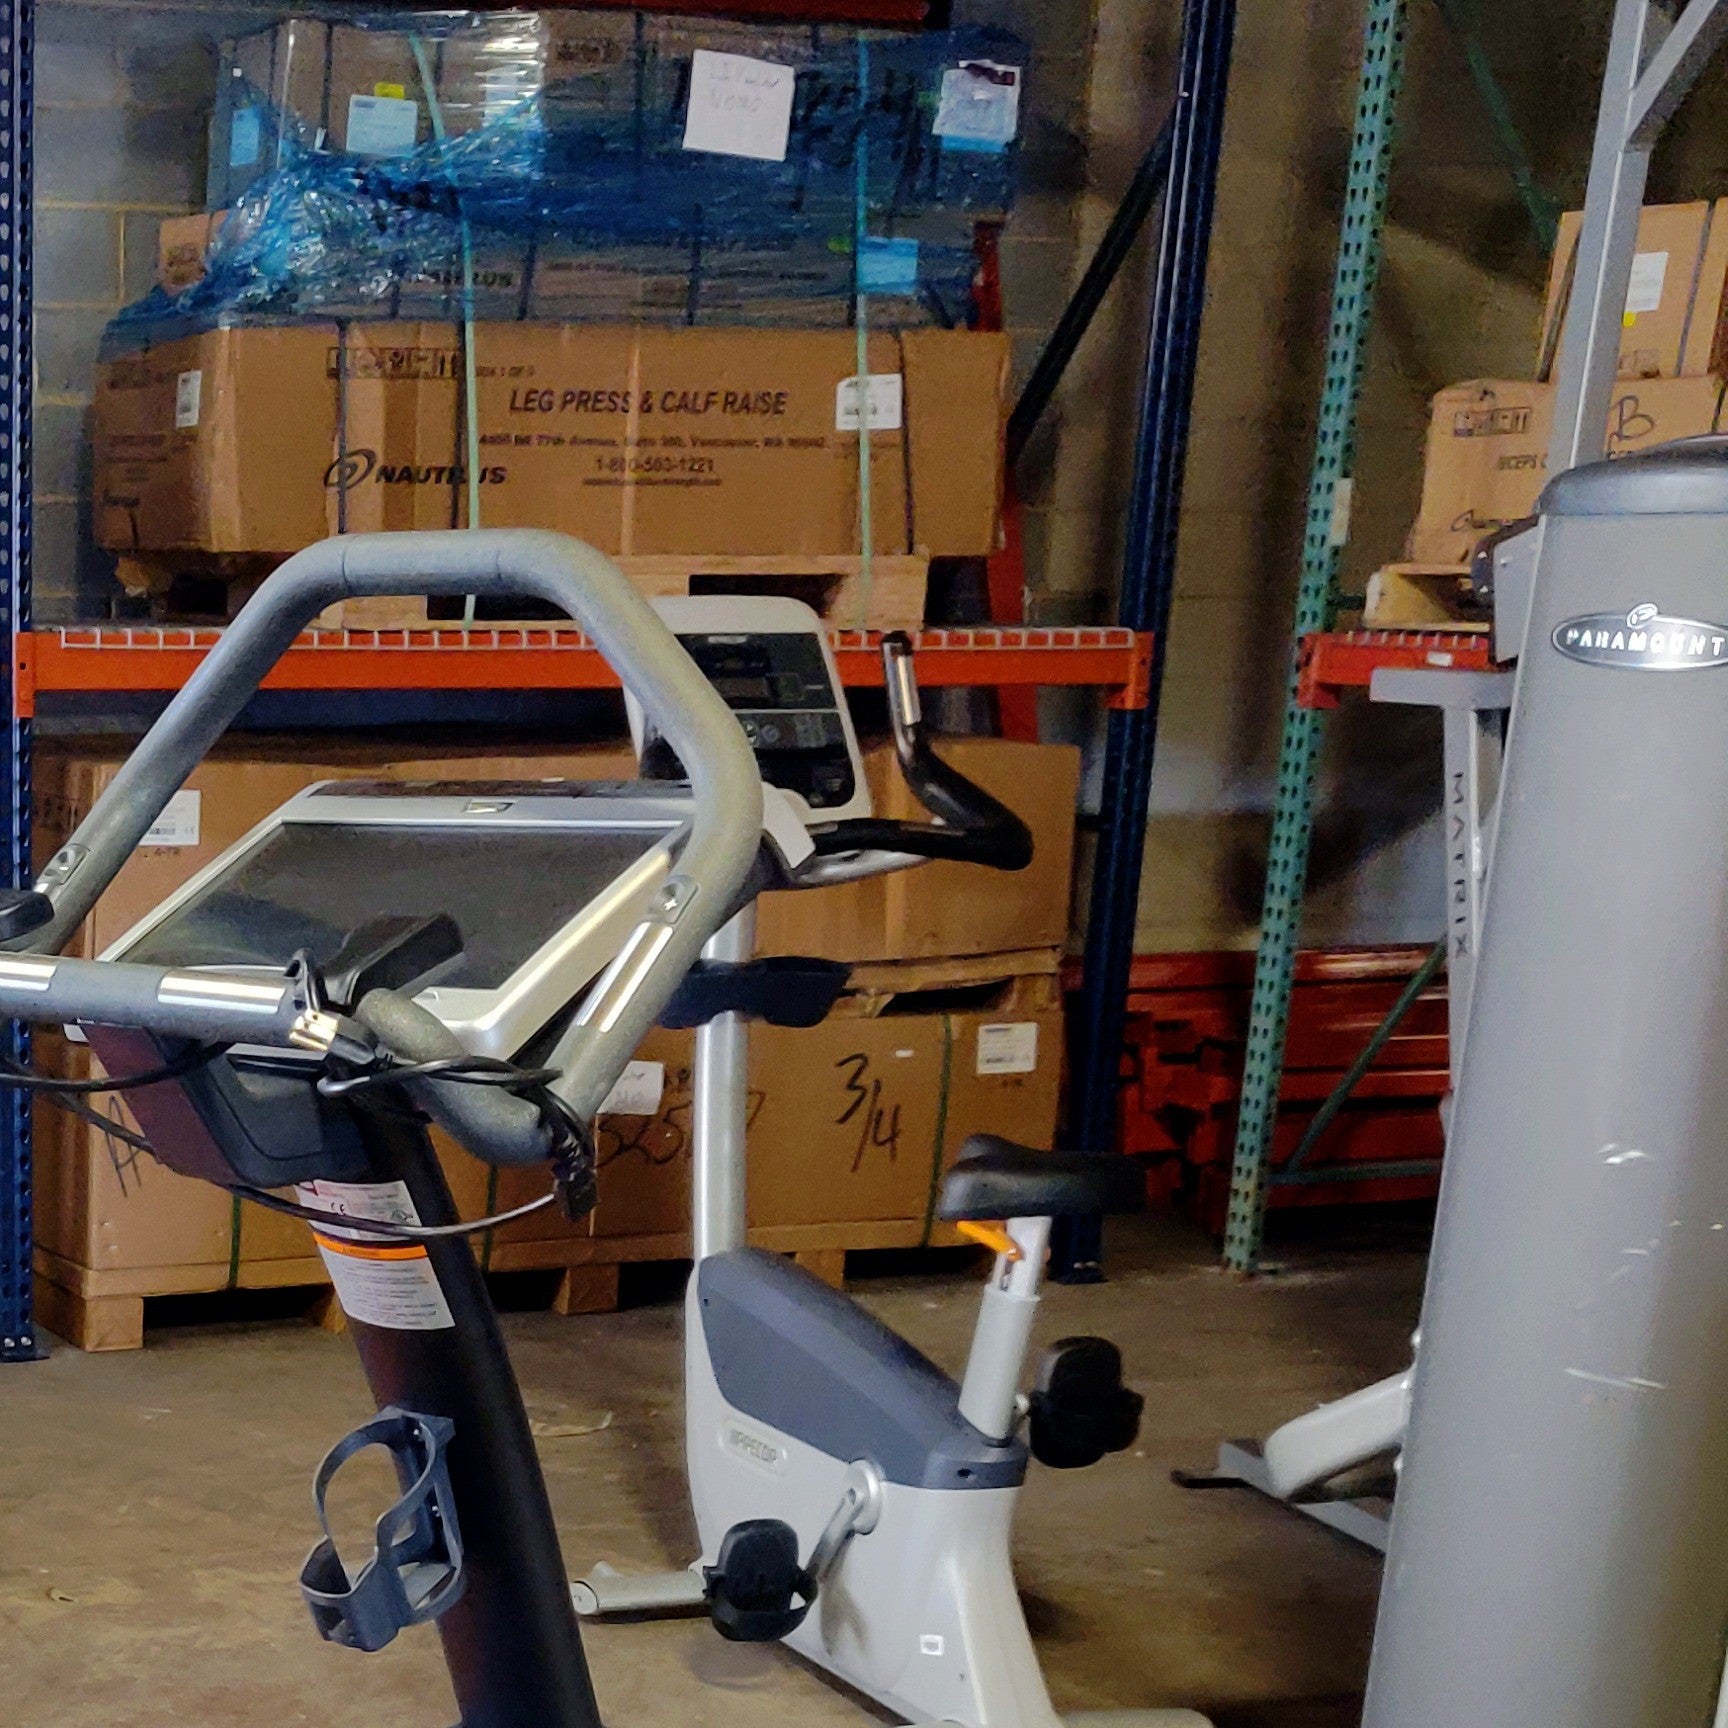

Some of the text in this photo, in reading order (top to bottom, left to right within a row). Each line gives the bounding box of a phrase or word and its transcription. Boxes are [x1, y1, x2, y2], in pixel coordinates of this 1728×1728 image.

[509, 389, 788, 414] LEG PRESS & CALF RAISE
[1566, 628, 1726, 657] PARAMOUNT
[835, 1053, 901, 1172] 3/4
